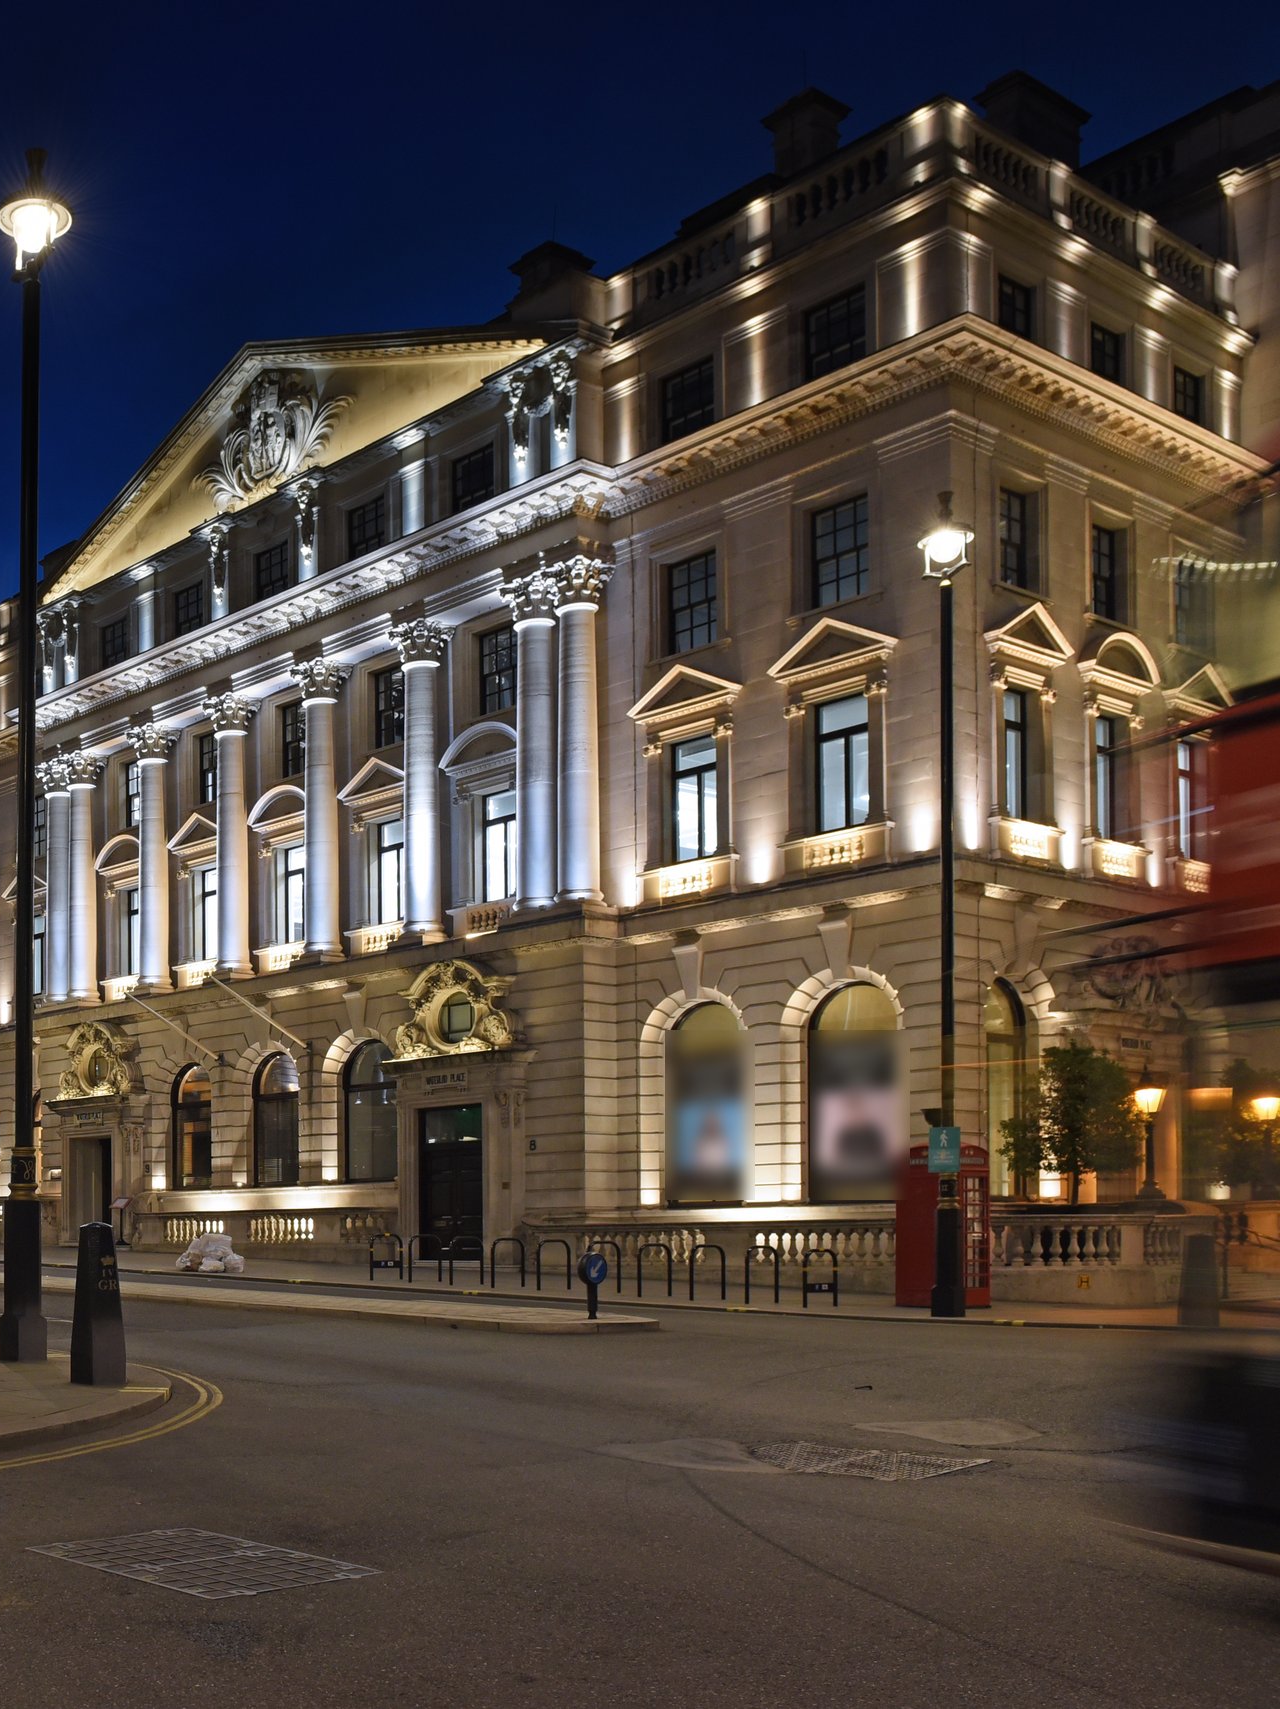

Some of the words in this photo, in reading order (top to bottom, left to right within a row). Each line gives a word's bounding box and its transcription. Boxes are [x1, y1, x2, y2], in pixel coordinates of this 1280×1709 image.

[529, 1140, 537, 1151] 8
[144, 1164, 150, 1174] 9
[98, 1279, 118, 1290] GR
